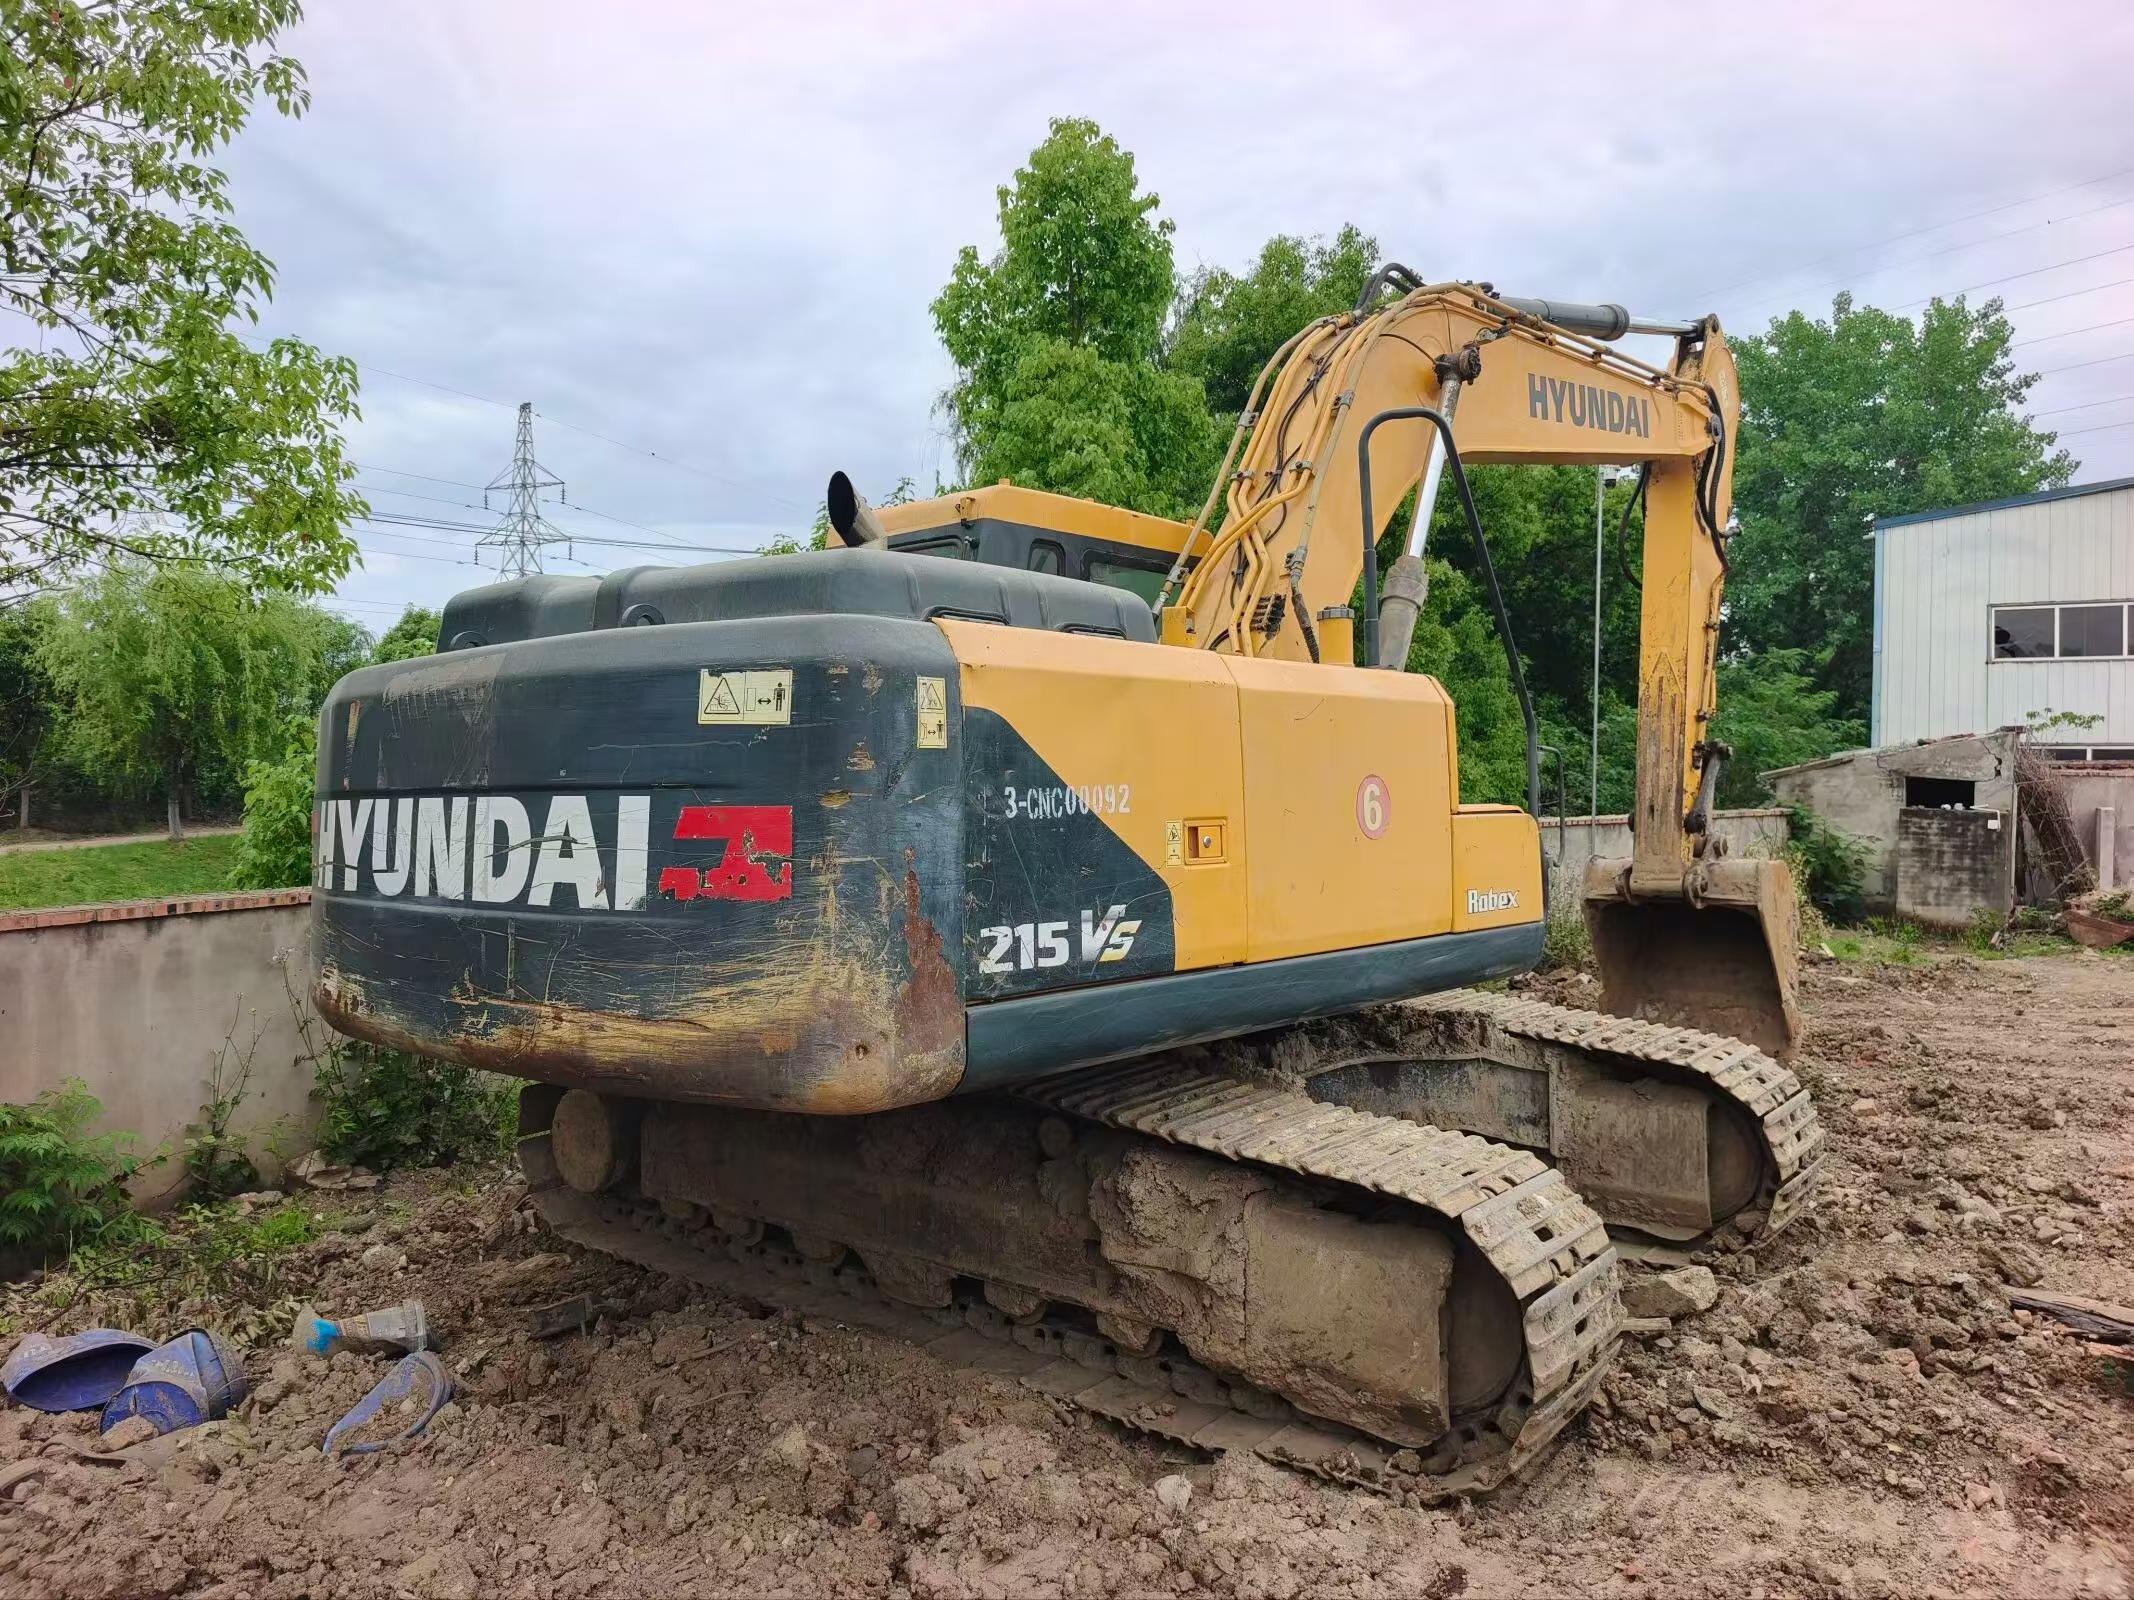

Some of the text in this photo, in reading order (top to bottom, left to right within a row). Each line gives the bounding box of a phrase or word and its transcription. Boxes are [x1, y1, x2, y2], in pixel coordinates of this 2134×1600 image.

[1527, 372, 1649, 439] HYUNDAI
[1363, 783, 1382, 831] 6
[318, 795, 651, 911] HYUNDAI
[1467, 886, 1520, 914] Robex
[979, 920, 1070, 974] 215
